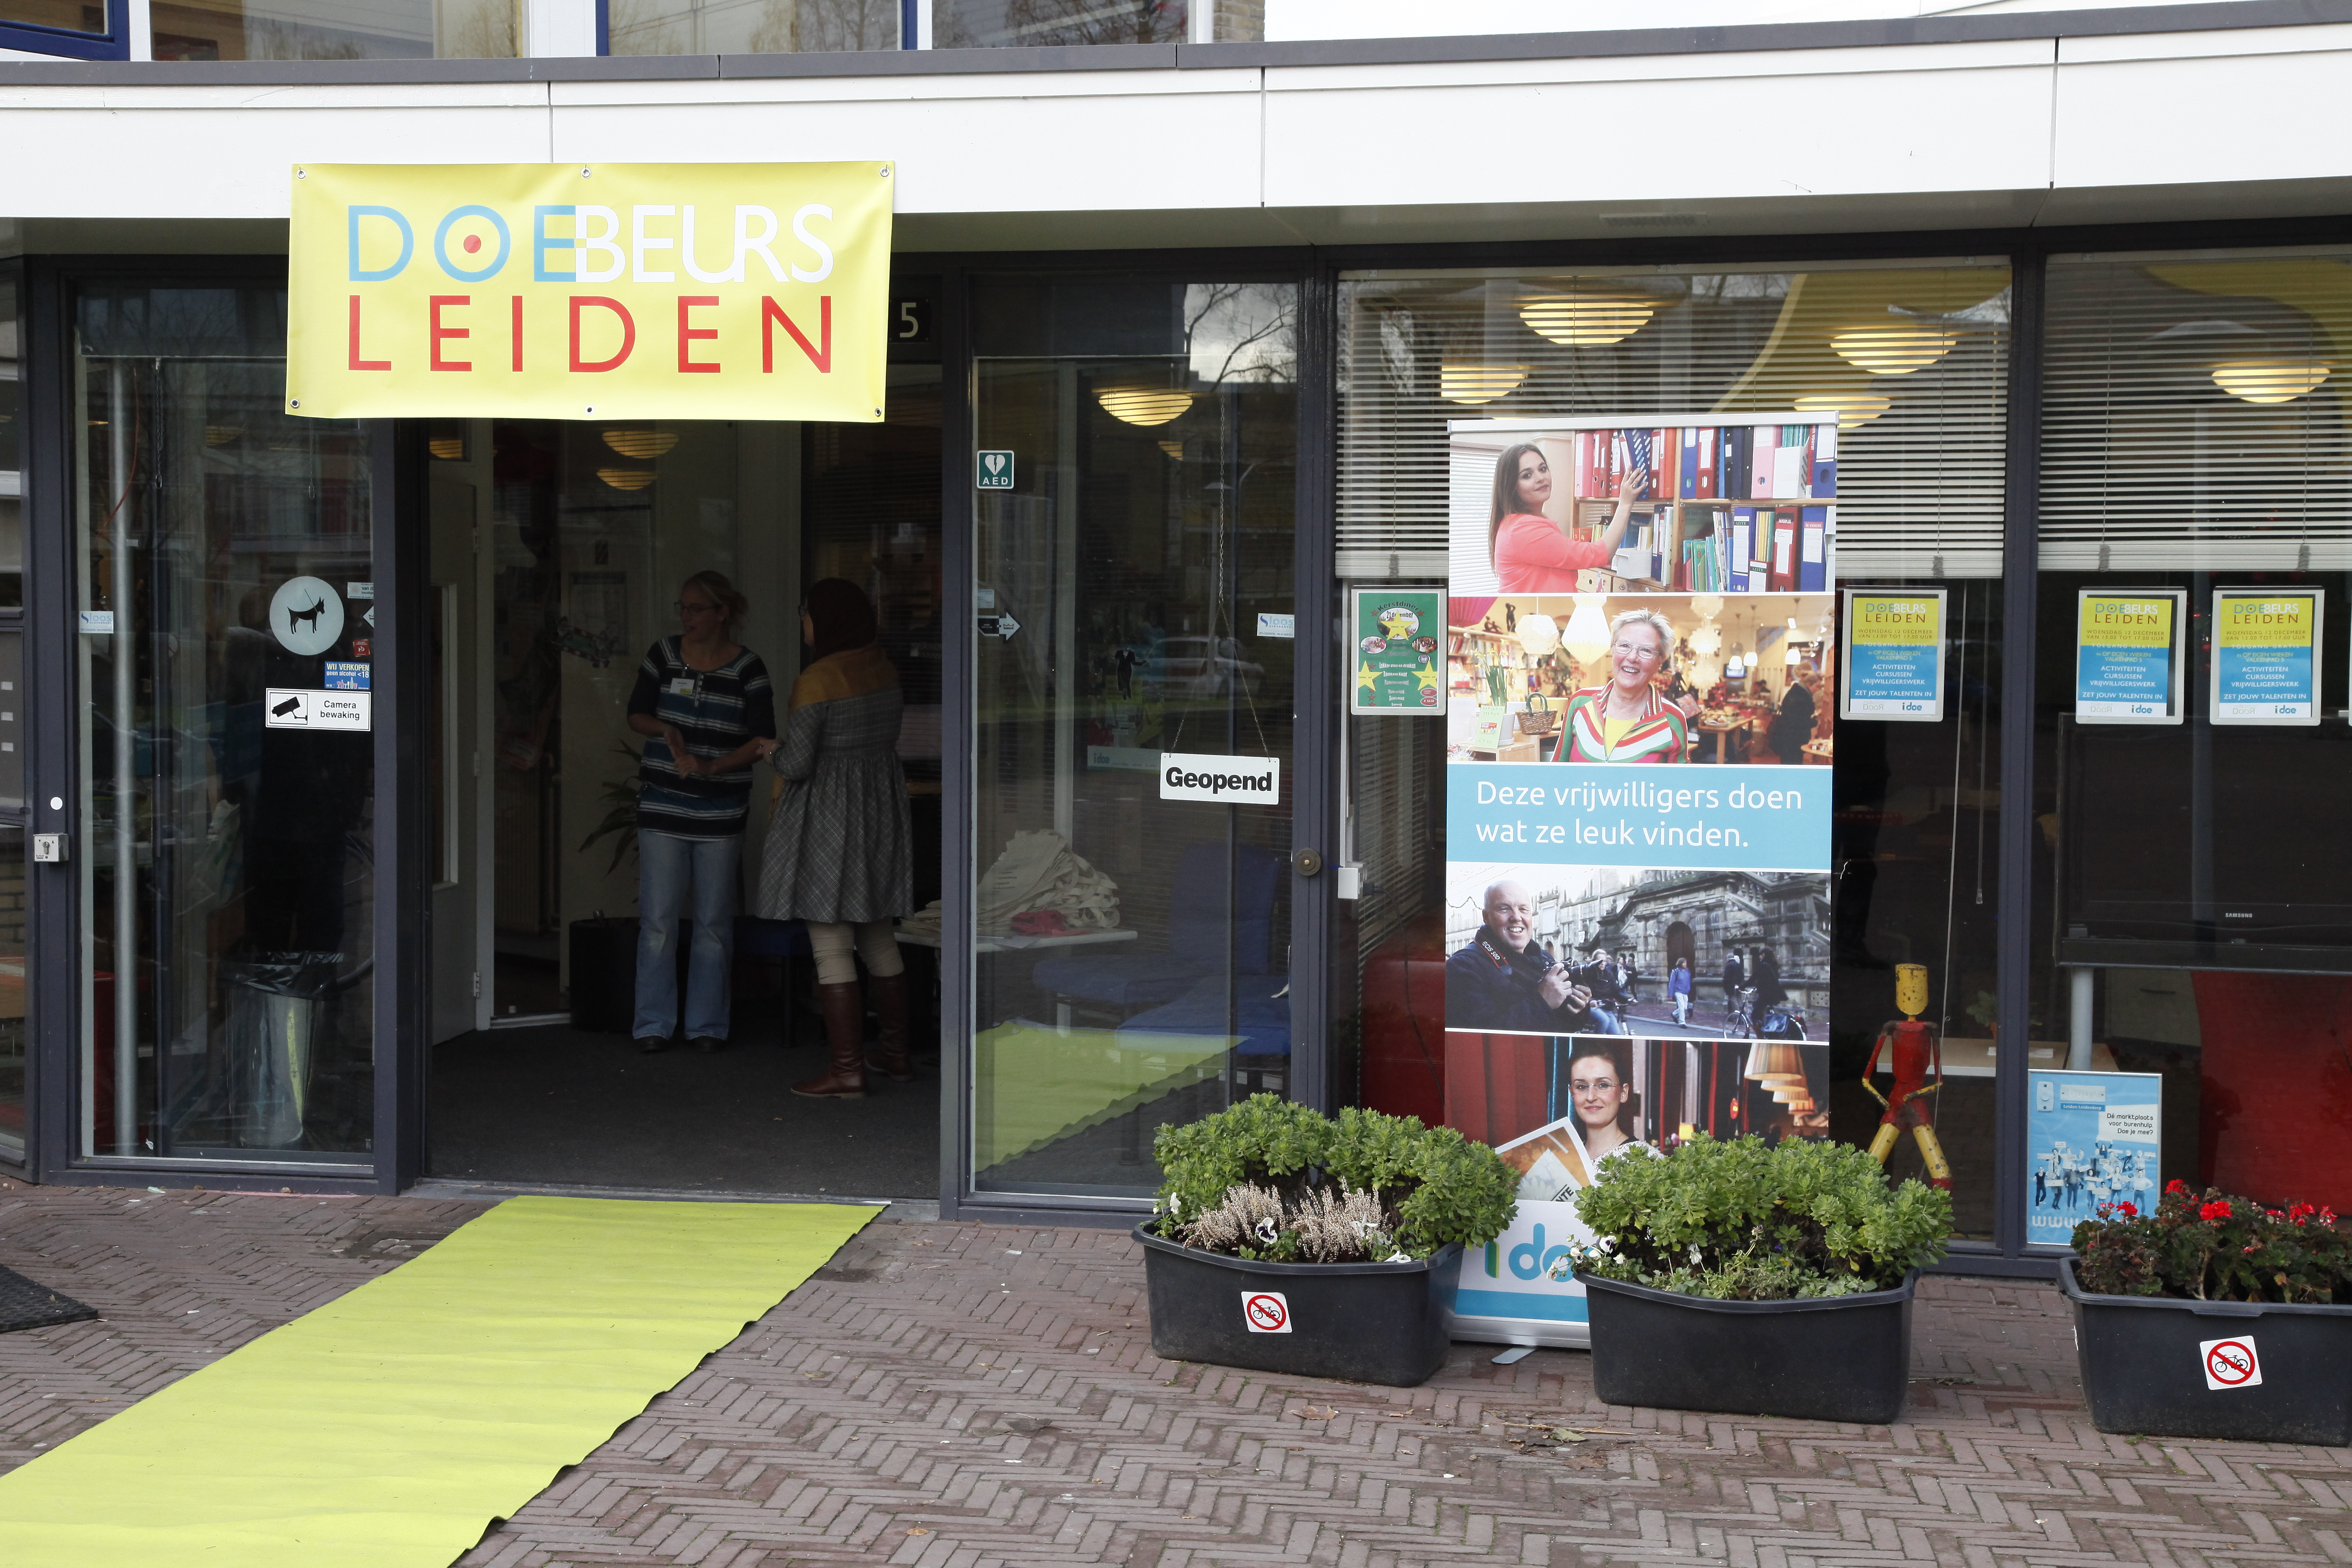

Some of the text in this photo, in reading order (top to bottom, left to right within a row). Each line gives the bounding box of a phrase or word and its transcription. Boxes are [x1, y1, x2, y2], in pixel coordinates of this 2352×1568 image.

[900, 302, 918, 338] 5
[348, 295, 832, 374] LEIDEN
[983, 477, 1008, 485] AED
[1377, 601, 1420, 612] Kerstdiner
[1866, 614, 1926, 623] LEIDEN
[2095, 614, 2157, 624] LEIDEN
[2234, 614, 2298, 624] LEIDEN
[324, 700, 356, 709] Camera
[320, 710, 360, 721] bewaking
[1166, 766, 1272, 794] Geopend
[1477, 781, 1802, 813] Deze vrijwilligers doen
[1475, 819, 1749, 848] wat ze leuk vinden.
[1482, 941, 1501, 960] EOS 50D
